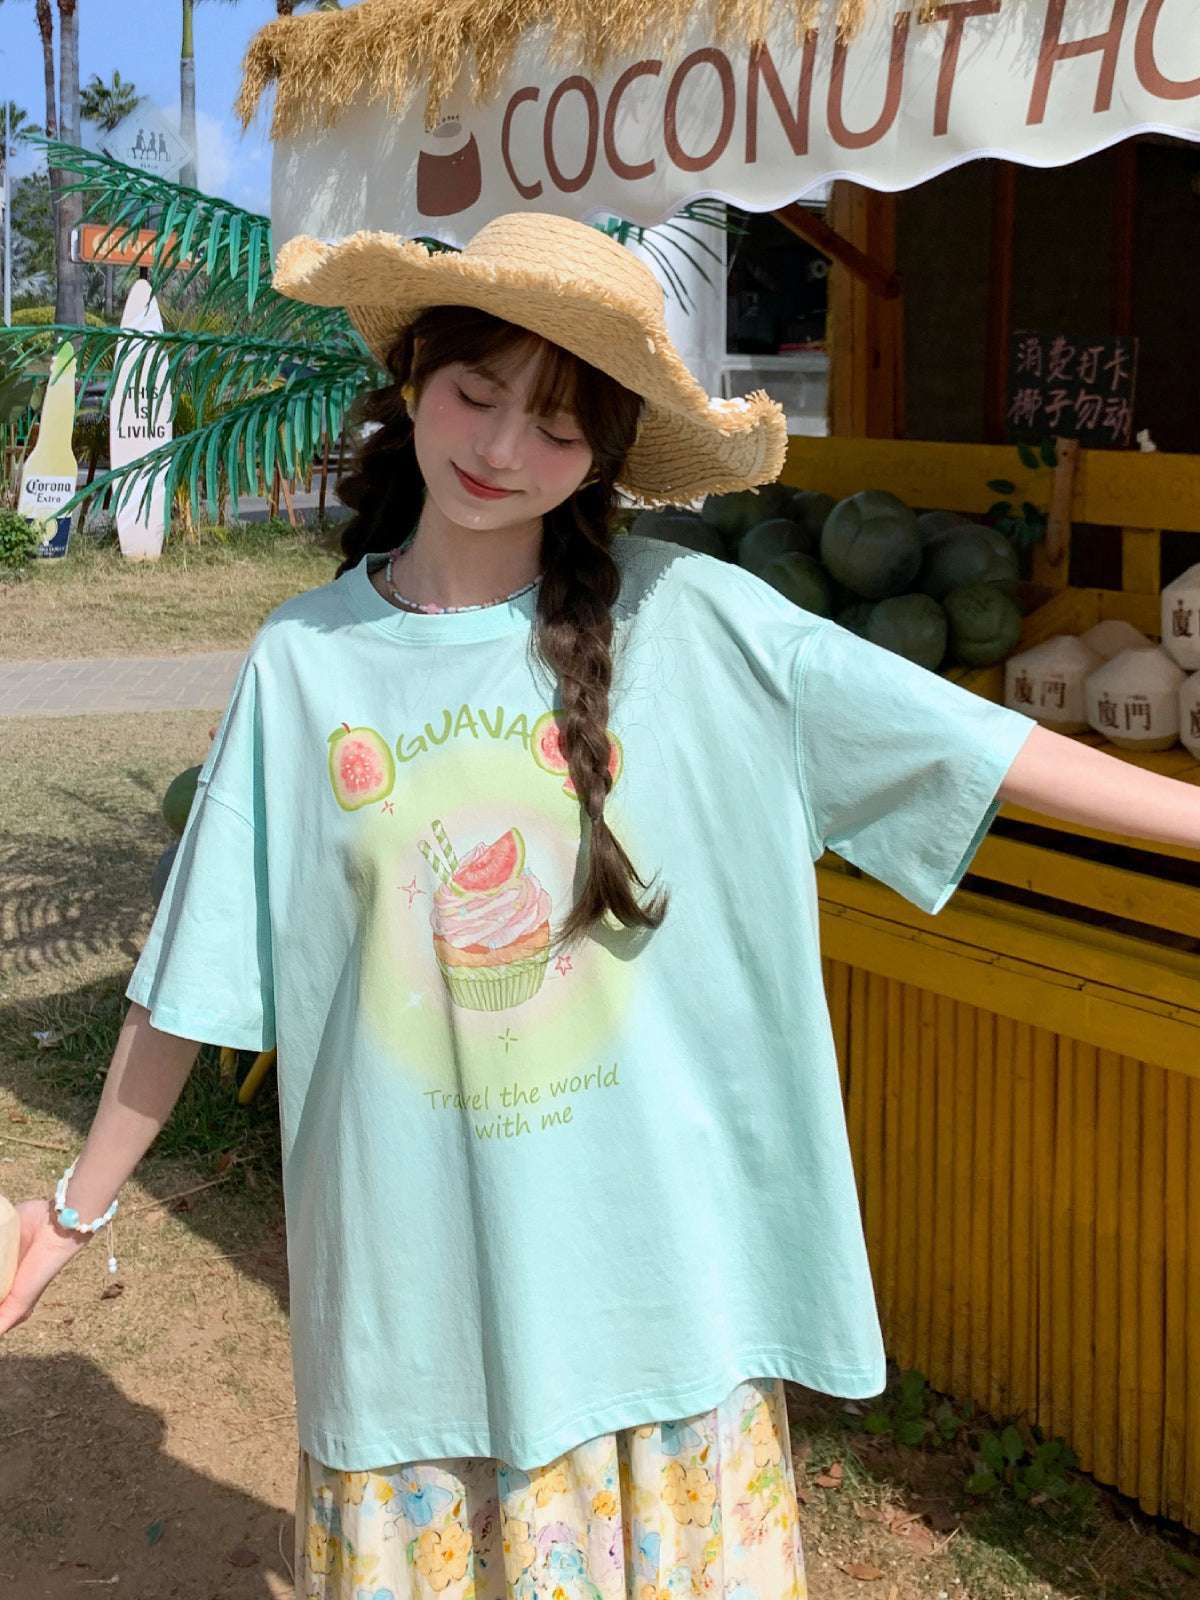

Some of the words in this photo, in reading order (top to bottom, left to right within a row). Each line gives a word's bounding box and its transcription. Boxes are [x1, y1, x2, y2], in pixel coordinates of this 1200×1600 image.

[501, 0, 1000, 199] COCONUT
[1016, 336, 1129, 391] 消费打卡
[127, 386, 159, 399] THS
[119, 425, 165, 439] LIVING
[1007, 388, 1130, 440] 椰子勿动
[26, 479, 72, 494] Corona
[36, 492, 62, 503] Extra
[1171, 599, 1200, 639] 廈
[396, 704, 532, 763] GUAVA
[424, 1086, 489, 1111] Travel
[500, 1083, 541, 1108] the
[550, 1063, 619, 1097] world
[475, 1113, 531, 1140] with
[541, 1106, 574, 1130] me
